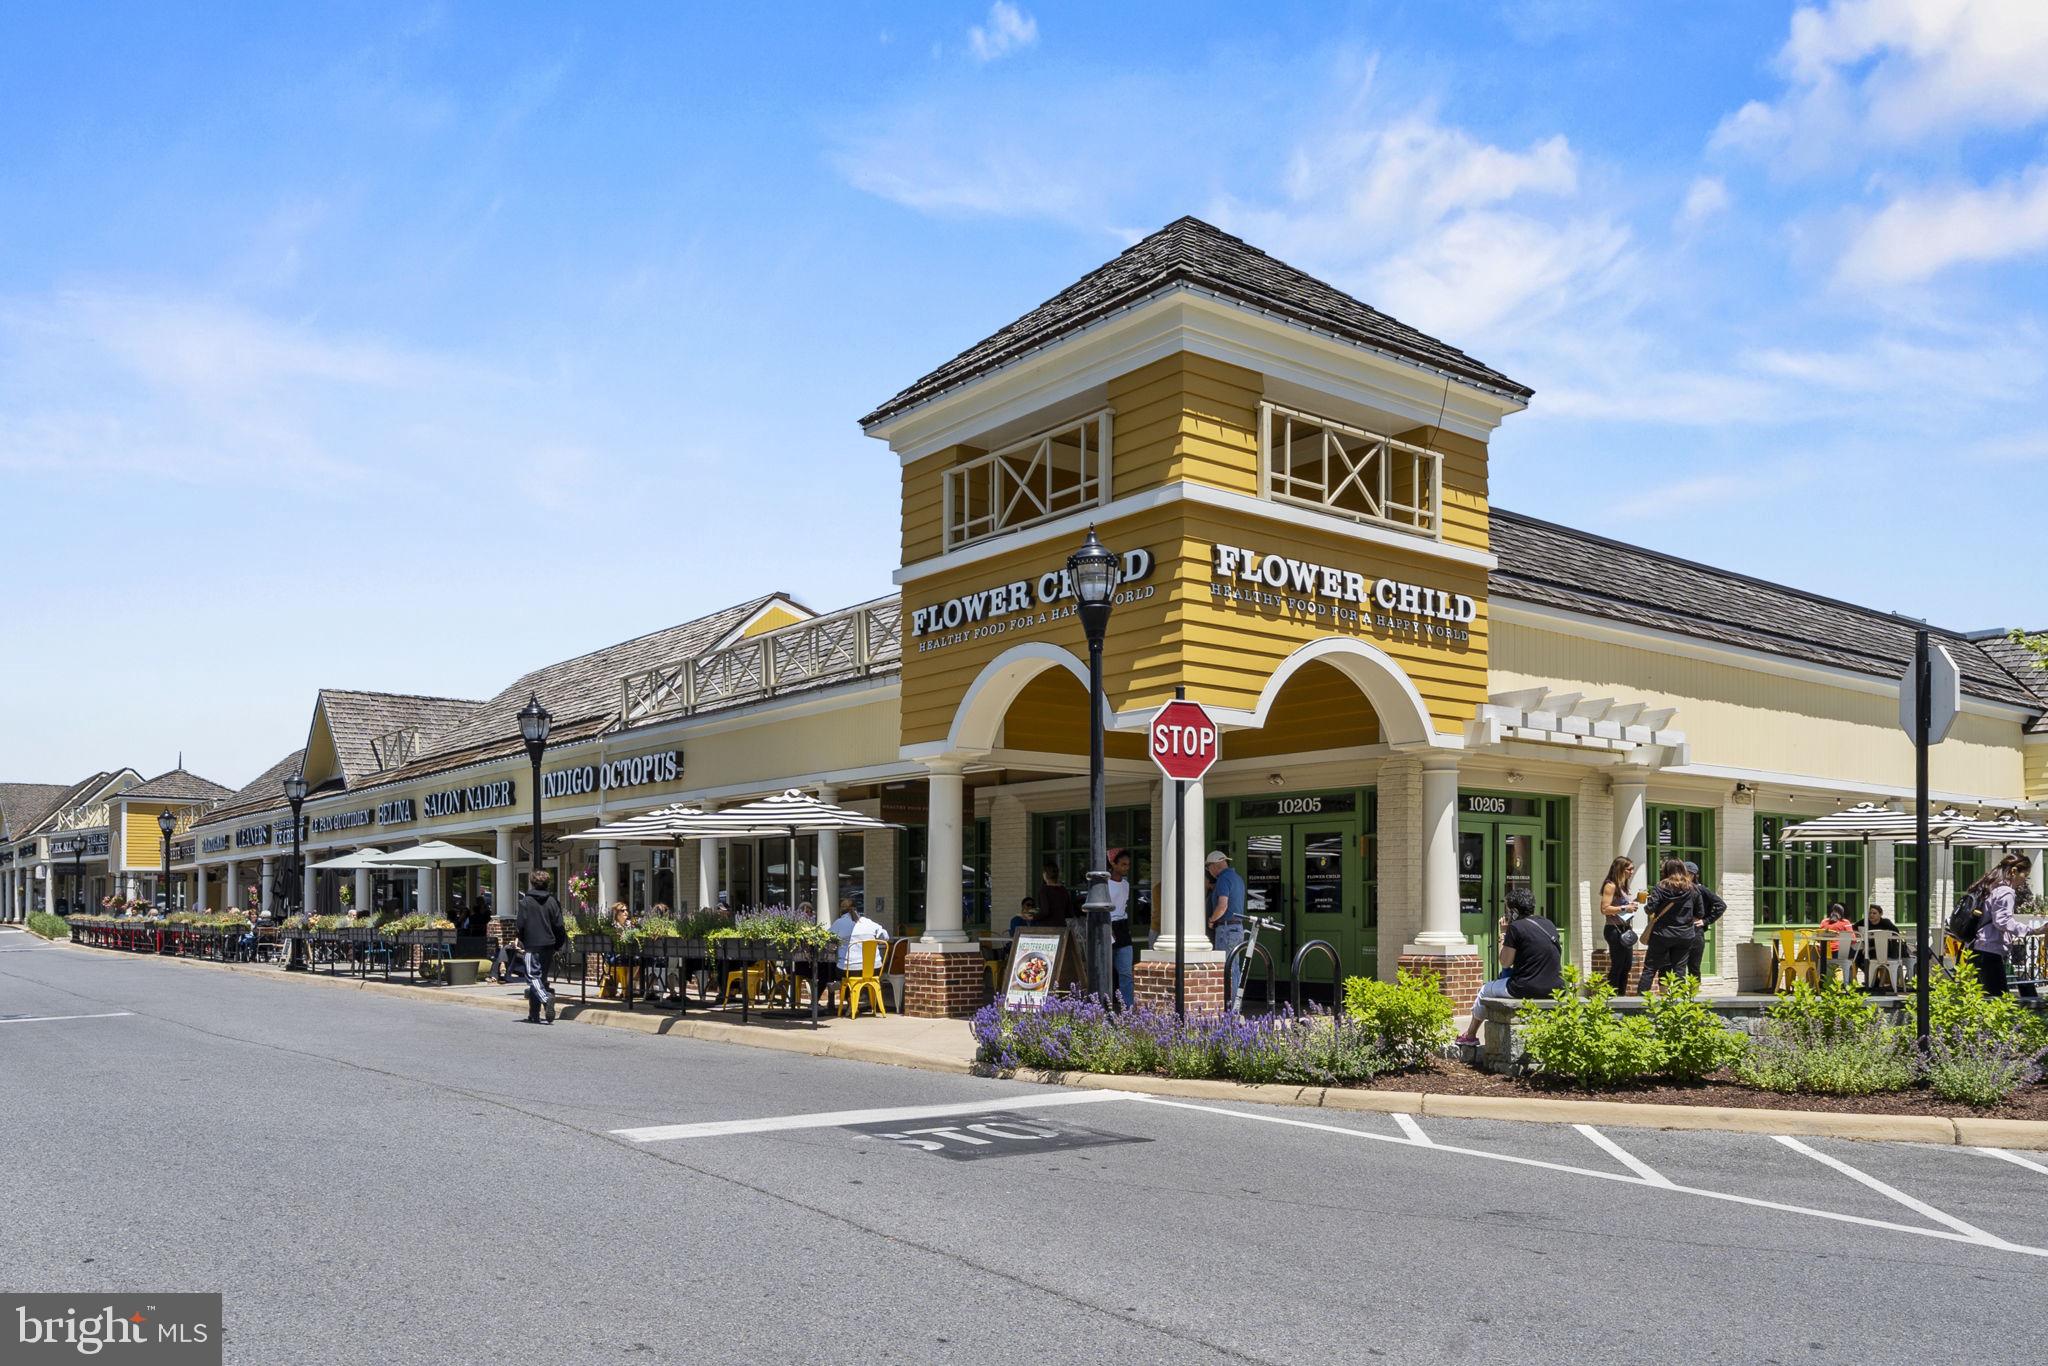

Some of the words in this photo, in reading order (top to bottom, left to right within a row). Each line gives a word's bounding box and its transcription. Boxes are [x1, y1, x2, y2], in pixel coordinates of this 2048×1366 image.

[911, 580, 1030, 637] FLOWER
[1037, 548, 1149, 604] CHD
[1215, 543, 1369, 603] FLOWER
[1374, 578, 1477, 623] CHILD
[918, 630, 971, 653] HEALTHY
[974, 623, 1006, 639] FOOD
[1010, 615, 1034, 631] FOR
[1038, 612, 1047, 624] A
[1051, 603, 1079, 620] HAP
[1114, 585, 1154, 605] ORLD
[1210, 583, 1282, 607] HEALTHY
[1289, 598, 1326, 615] FOOD
[1331, 606, 1358, 621] FOR
[1362, 612, 1373, 624] A
[1377, 614, 1421, 632] HAPPY
[1424, 623, 1469, 641] WORLD
[1154, 724, 1214, 756] STOP
[541, 766, 594, 799] INDIGO
[600, 750, 677, 791] OCTOPUS
[378, 799, 412, 826] BELINA
[424, 789, 461, 818] SALON
[466, 780, 511, 812] NADER
[1277, 797, 1322, 814] 10205
[1469, 796, 1506, 814] 10205
[283, 826, 304, 844] CREM
[311, 818, 319, 833] LE
[319, 815, 333, 832] PAIN
[333, 809, 370, 831] QUOTIDIEN
[852, 1117, 1075, 1151] STO
